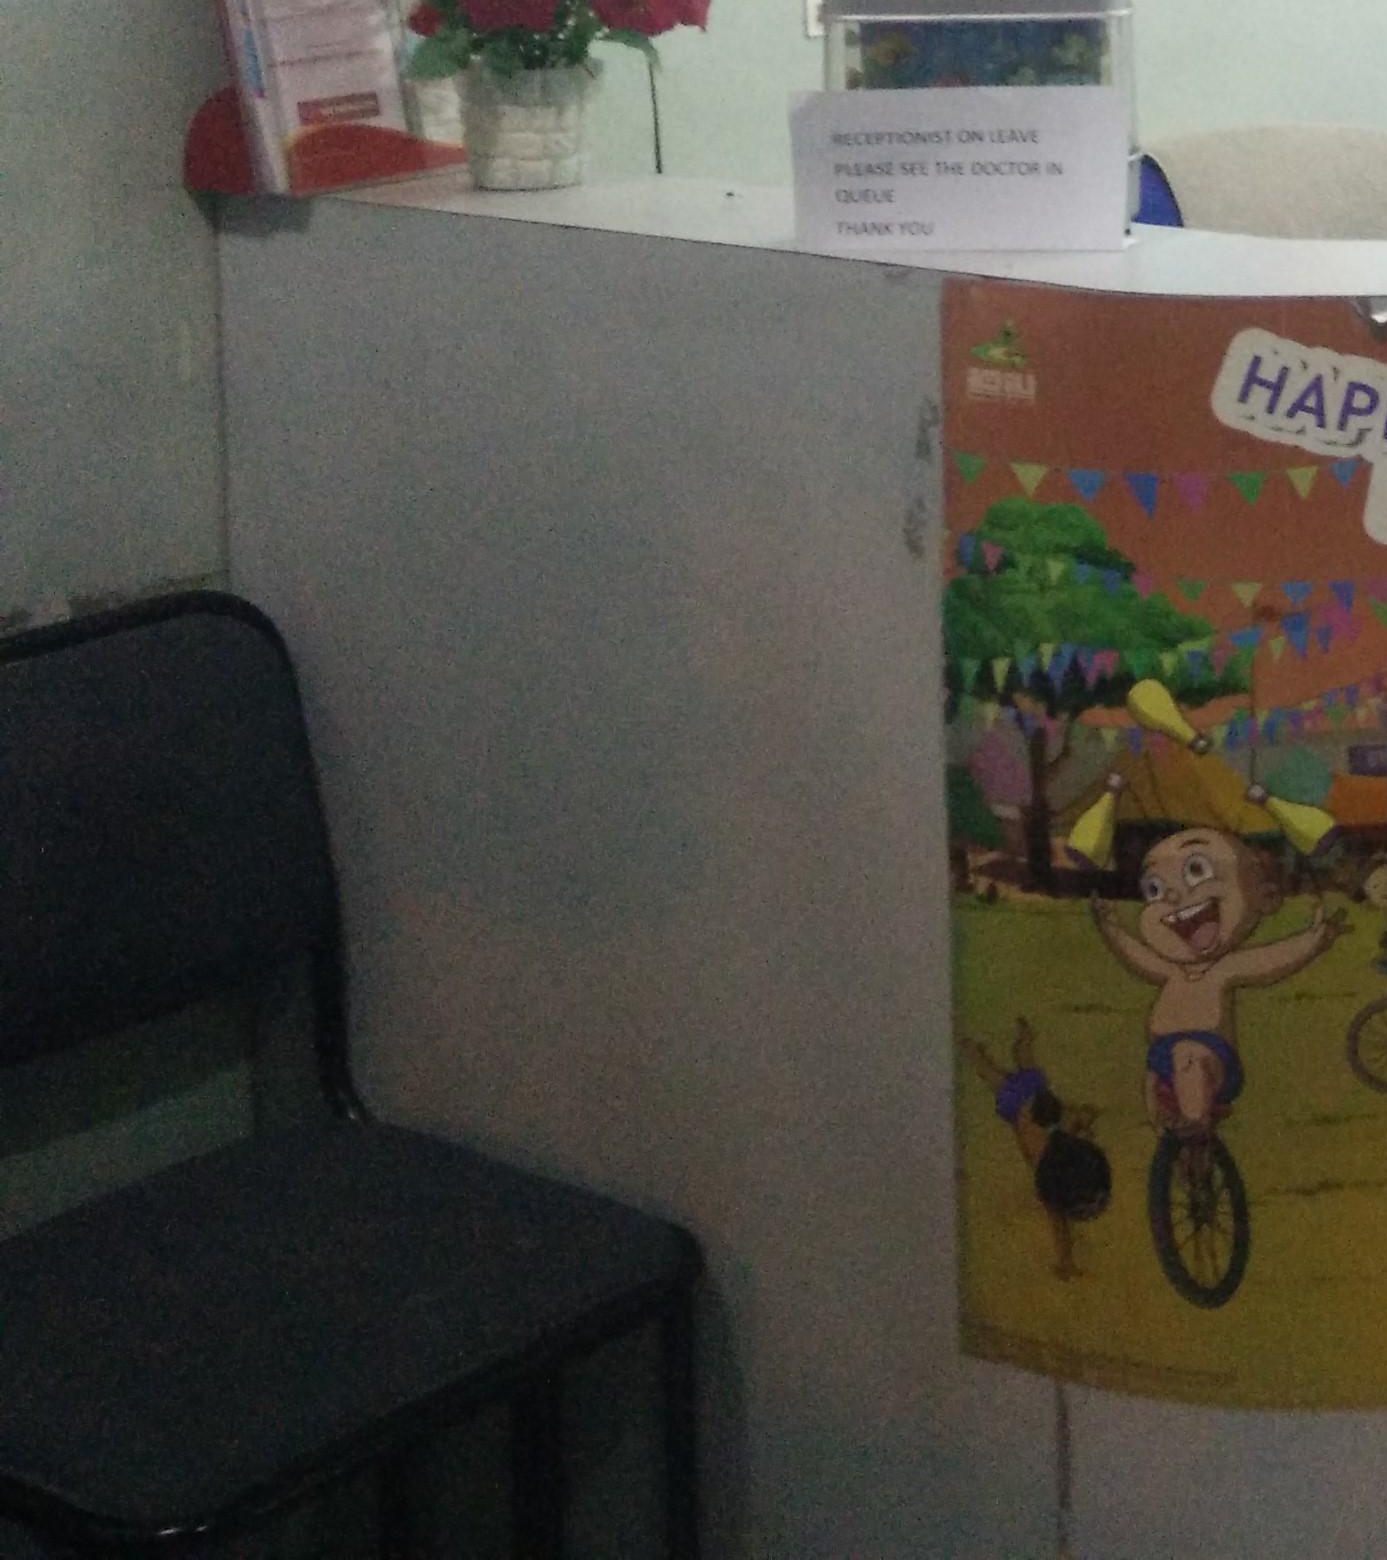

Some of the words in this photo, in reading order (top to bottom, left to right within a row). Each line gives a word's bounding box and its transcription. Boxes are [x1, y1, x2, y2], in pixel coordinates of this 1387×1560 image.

[957, 129, 984, 144] ON
[991, 128, 1039, 144] LEAVE
[834, 161, 895, 177] PLEASE
[901, 162, 929, 177] SEE
[935, 160, 966, 176] THE
[971, 161, 1041, 176] DOCTOR
[1046, 161, 1064, 176] IN
[835, 188, 895, 204] QUEUE
[836, 220, 894, 236] THANK
[898, 220, 935, 237] YOU
